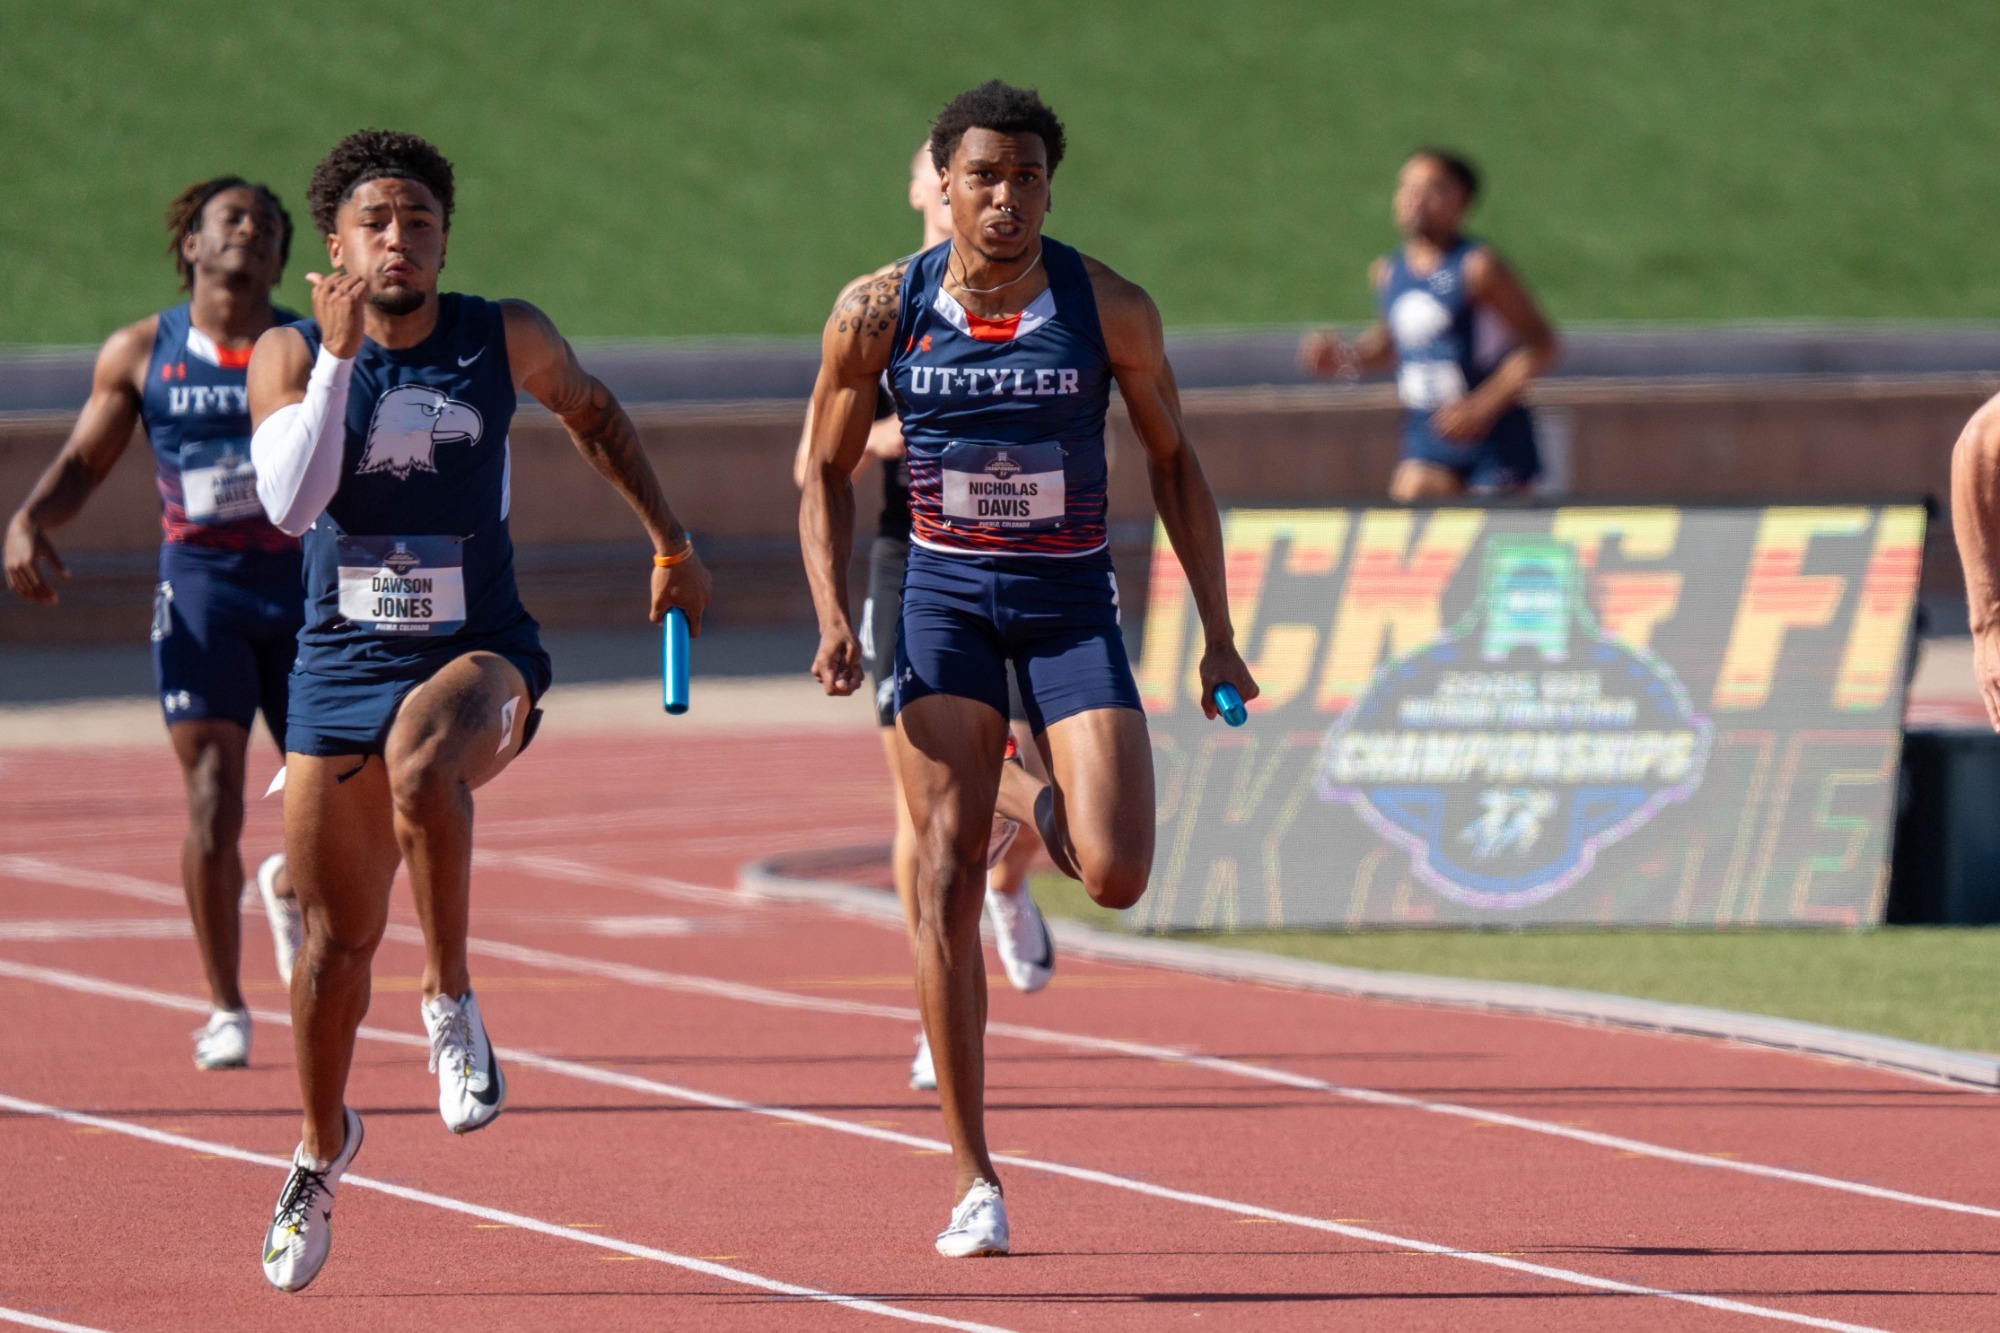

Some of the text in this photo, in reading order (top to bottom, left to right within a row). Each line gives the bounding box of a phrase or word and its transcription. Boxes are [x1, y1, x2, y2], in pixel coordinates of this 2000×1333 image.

[910, 366, 1079, 396] UT TYLER
[969, 482, 1038, 496] NICHOLAS
[978, 499, 1030, 517] DAVIS
[372, 577, 433, 593] DAWSON
[372, 597, 433, 618] JONES
